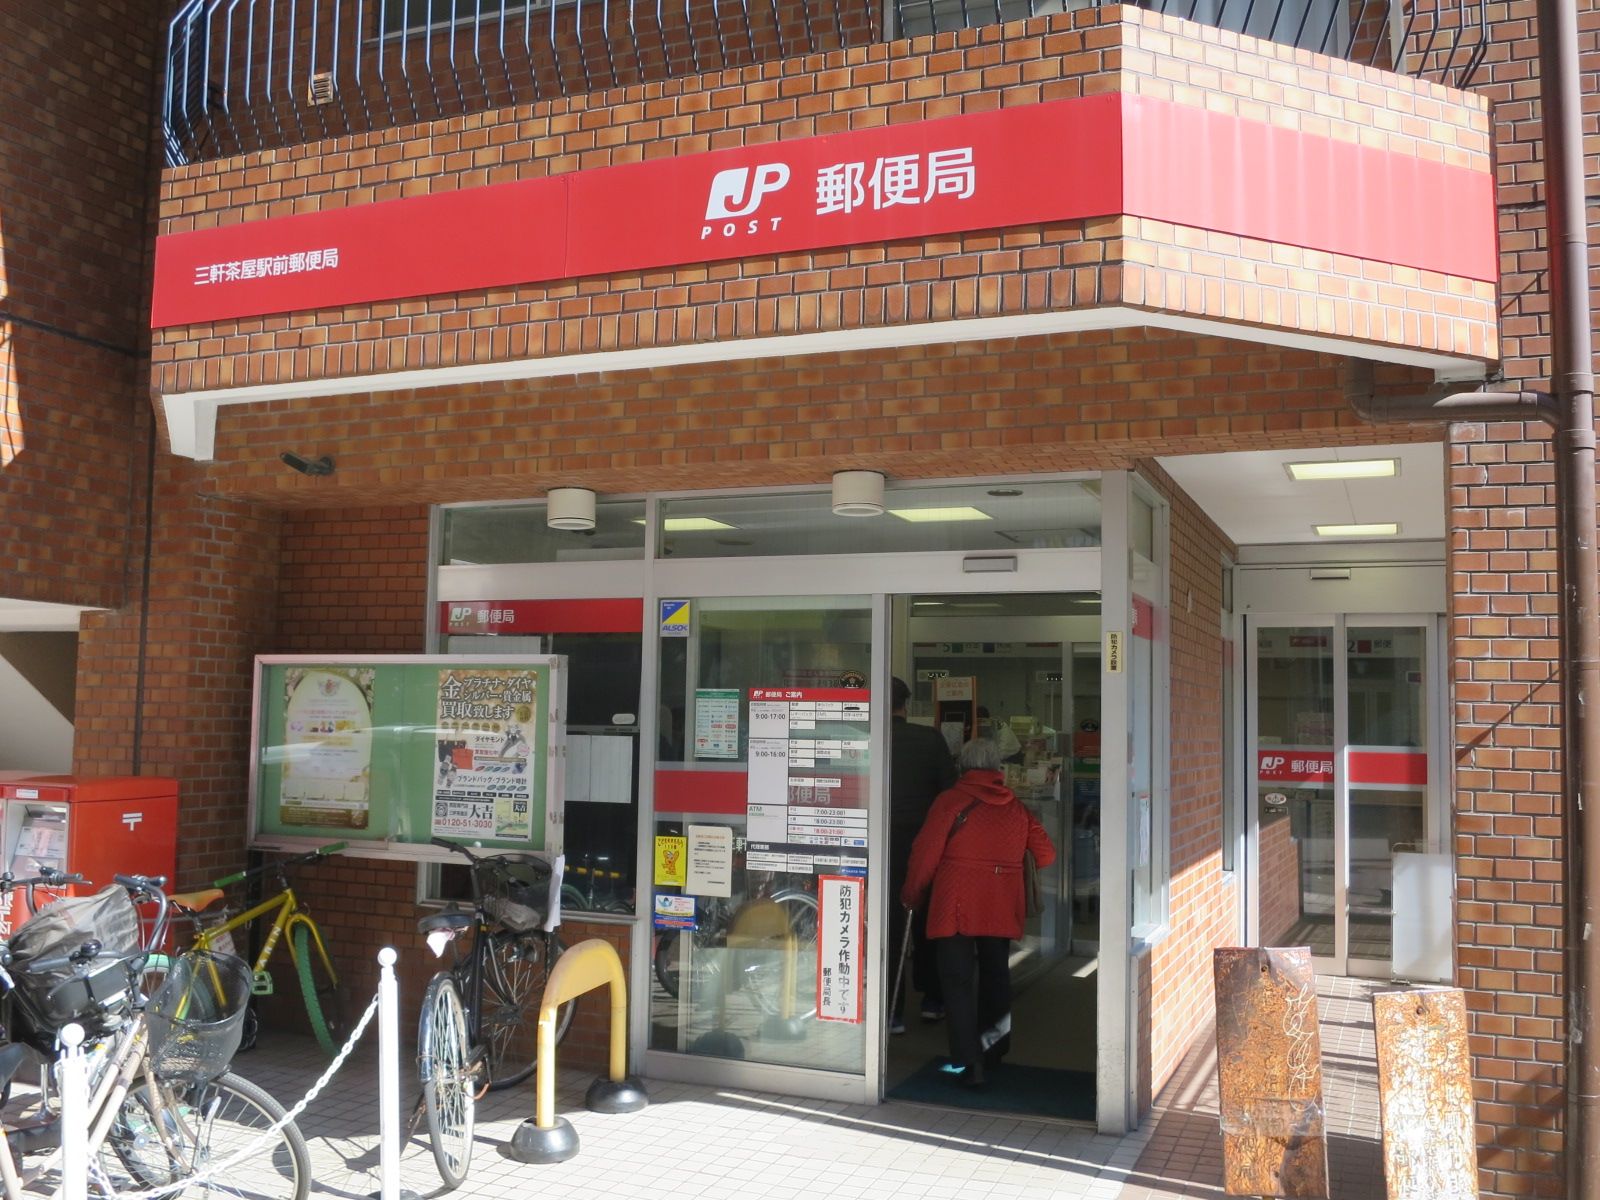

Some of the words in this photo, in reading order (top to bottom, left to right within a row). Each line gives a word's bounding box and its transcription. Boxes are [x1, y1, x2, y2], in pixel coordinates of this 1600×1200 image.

[815, 146, 976, 216] 郵便局
[700, 217, 782, 240] POST
[194, 247, 339, 285] 三軒茶屋駅前郵便局
[477, 609, 515, 624] 郵便局
[662, 624, 688, 632] ALSOK
[441, 674, 463, 700] 金
[441, 700, 515, 719] 買取致します
[755, 713, 786, 721] 9:00-17:00
[1291, 760, 1334, 775] 郵便局
[469, 804, 493, 820] 大吉
[838, 884, 852, 1015] 防犯カメラ作動中です
[822, 967, 832, 1007] 郵便局長
